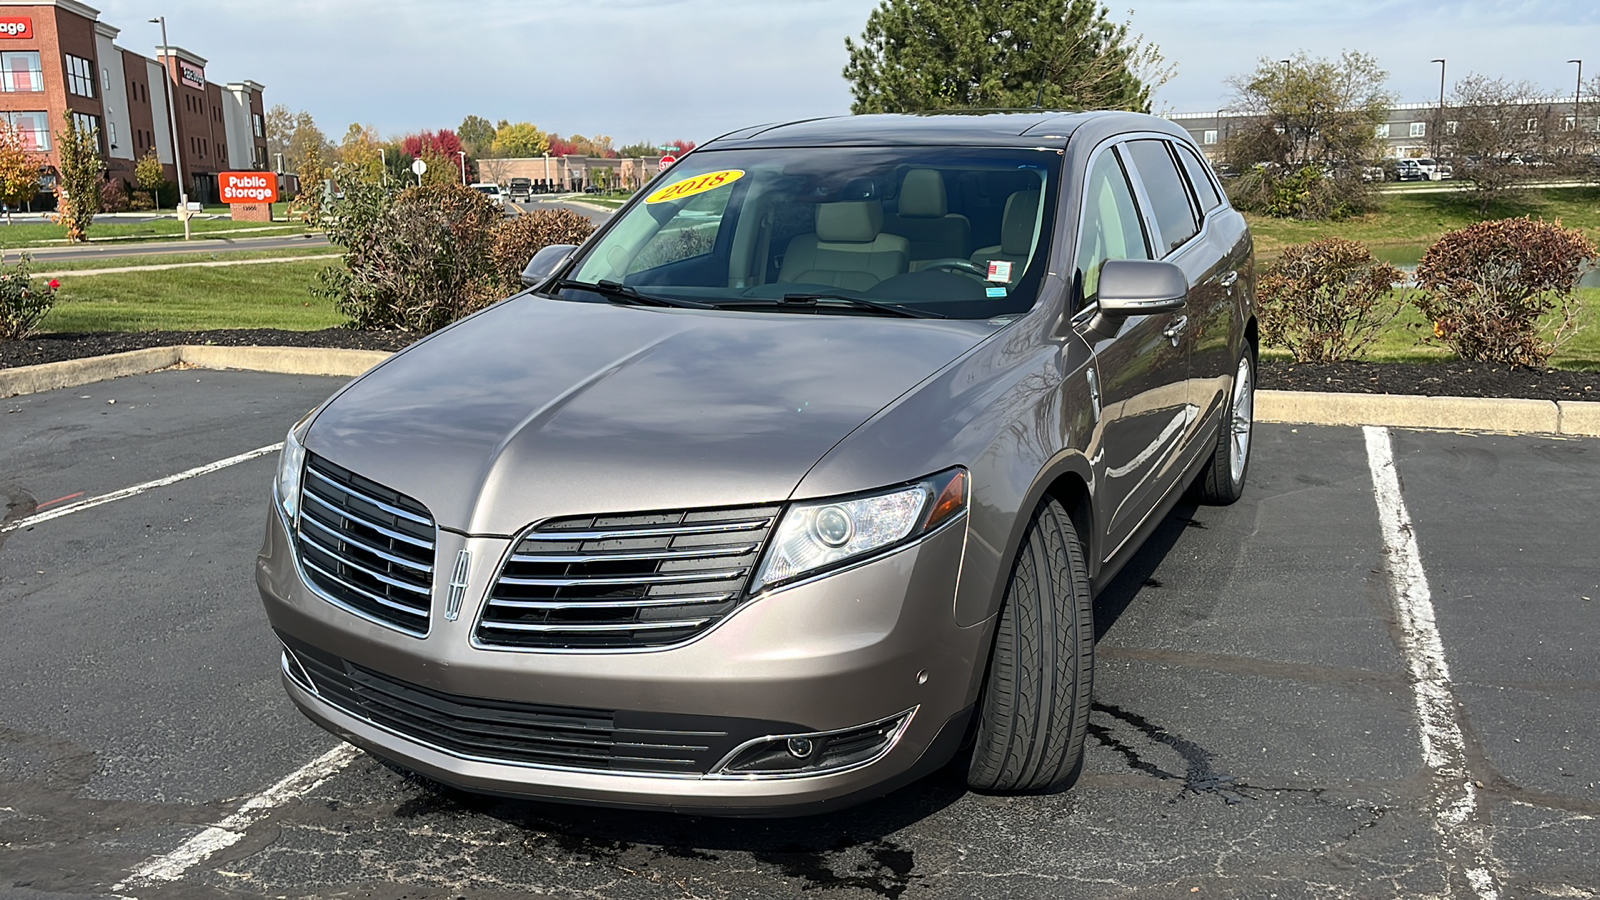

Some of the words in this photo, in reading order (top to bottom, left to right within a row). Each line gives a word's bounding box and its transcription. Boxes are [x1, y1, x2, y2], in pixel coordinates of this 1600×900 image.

[661, 161, 674, 169] STO
[229, 176, 267, 187] Public
[658, 172, 730, 201] 2018
[224, 187, 272, 200] Storage
